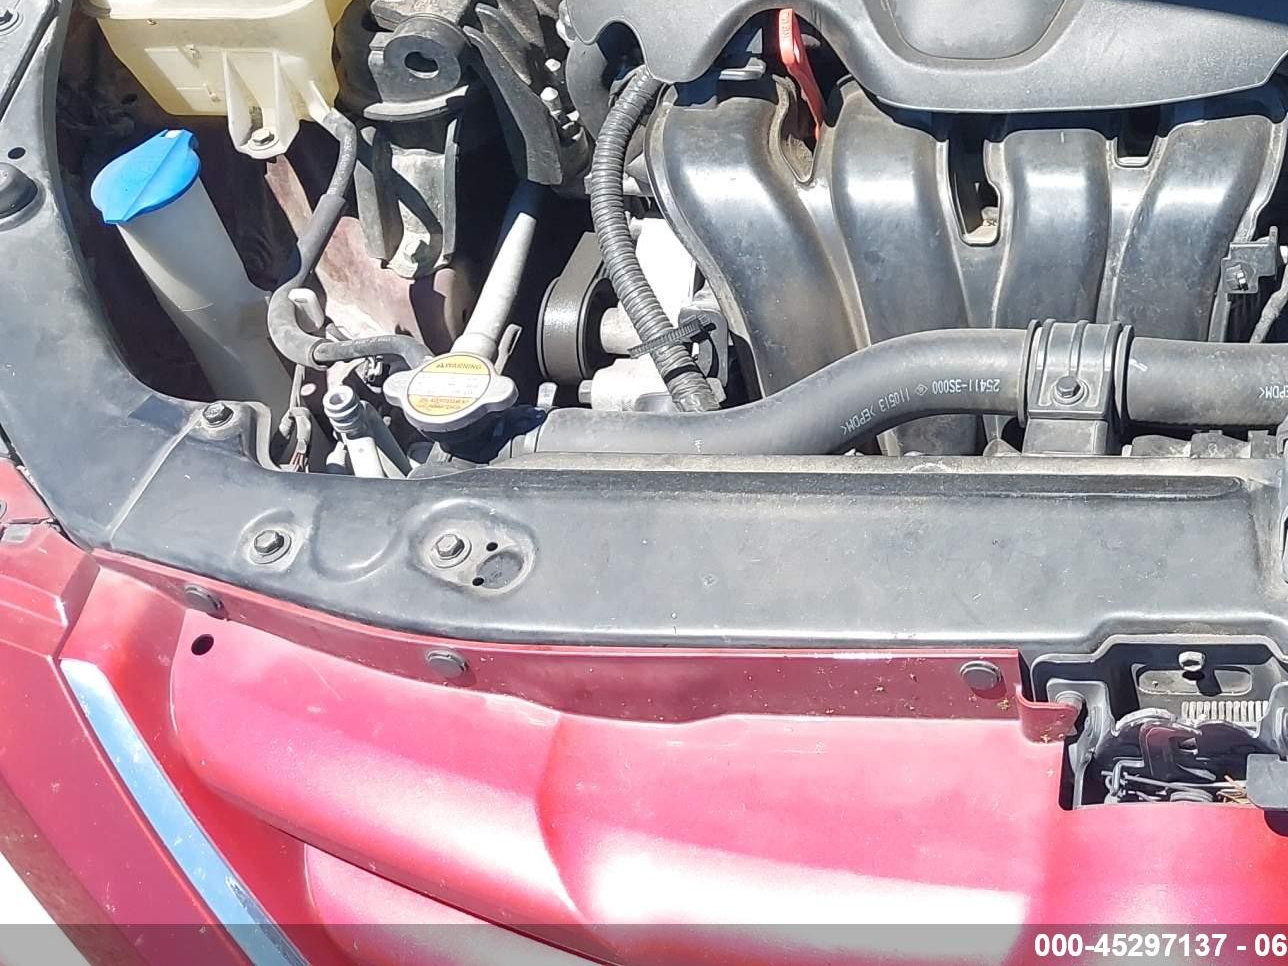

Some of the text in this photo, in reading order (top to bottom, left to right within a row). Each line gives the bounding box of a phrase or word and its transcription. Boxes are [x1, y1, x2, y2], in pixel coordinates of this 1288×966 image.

[445, 362, 482, 370] WARNING
[932, 378, 1001, 395] 25411-3S000
[878, 387, 910, 412] 110513
